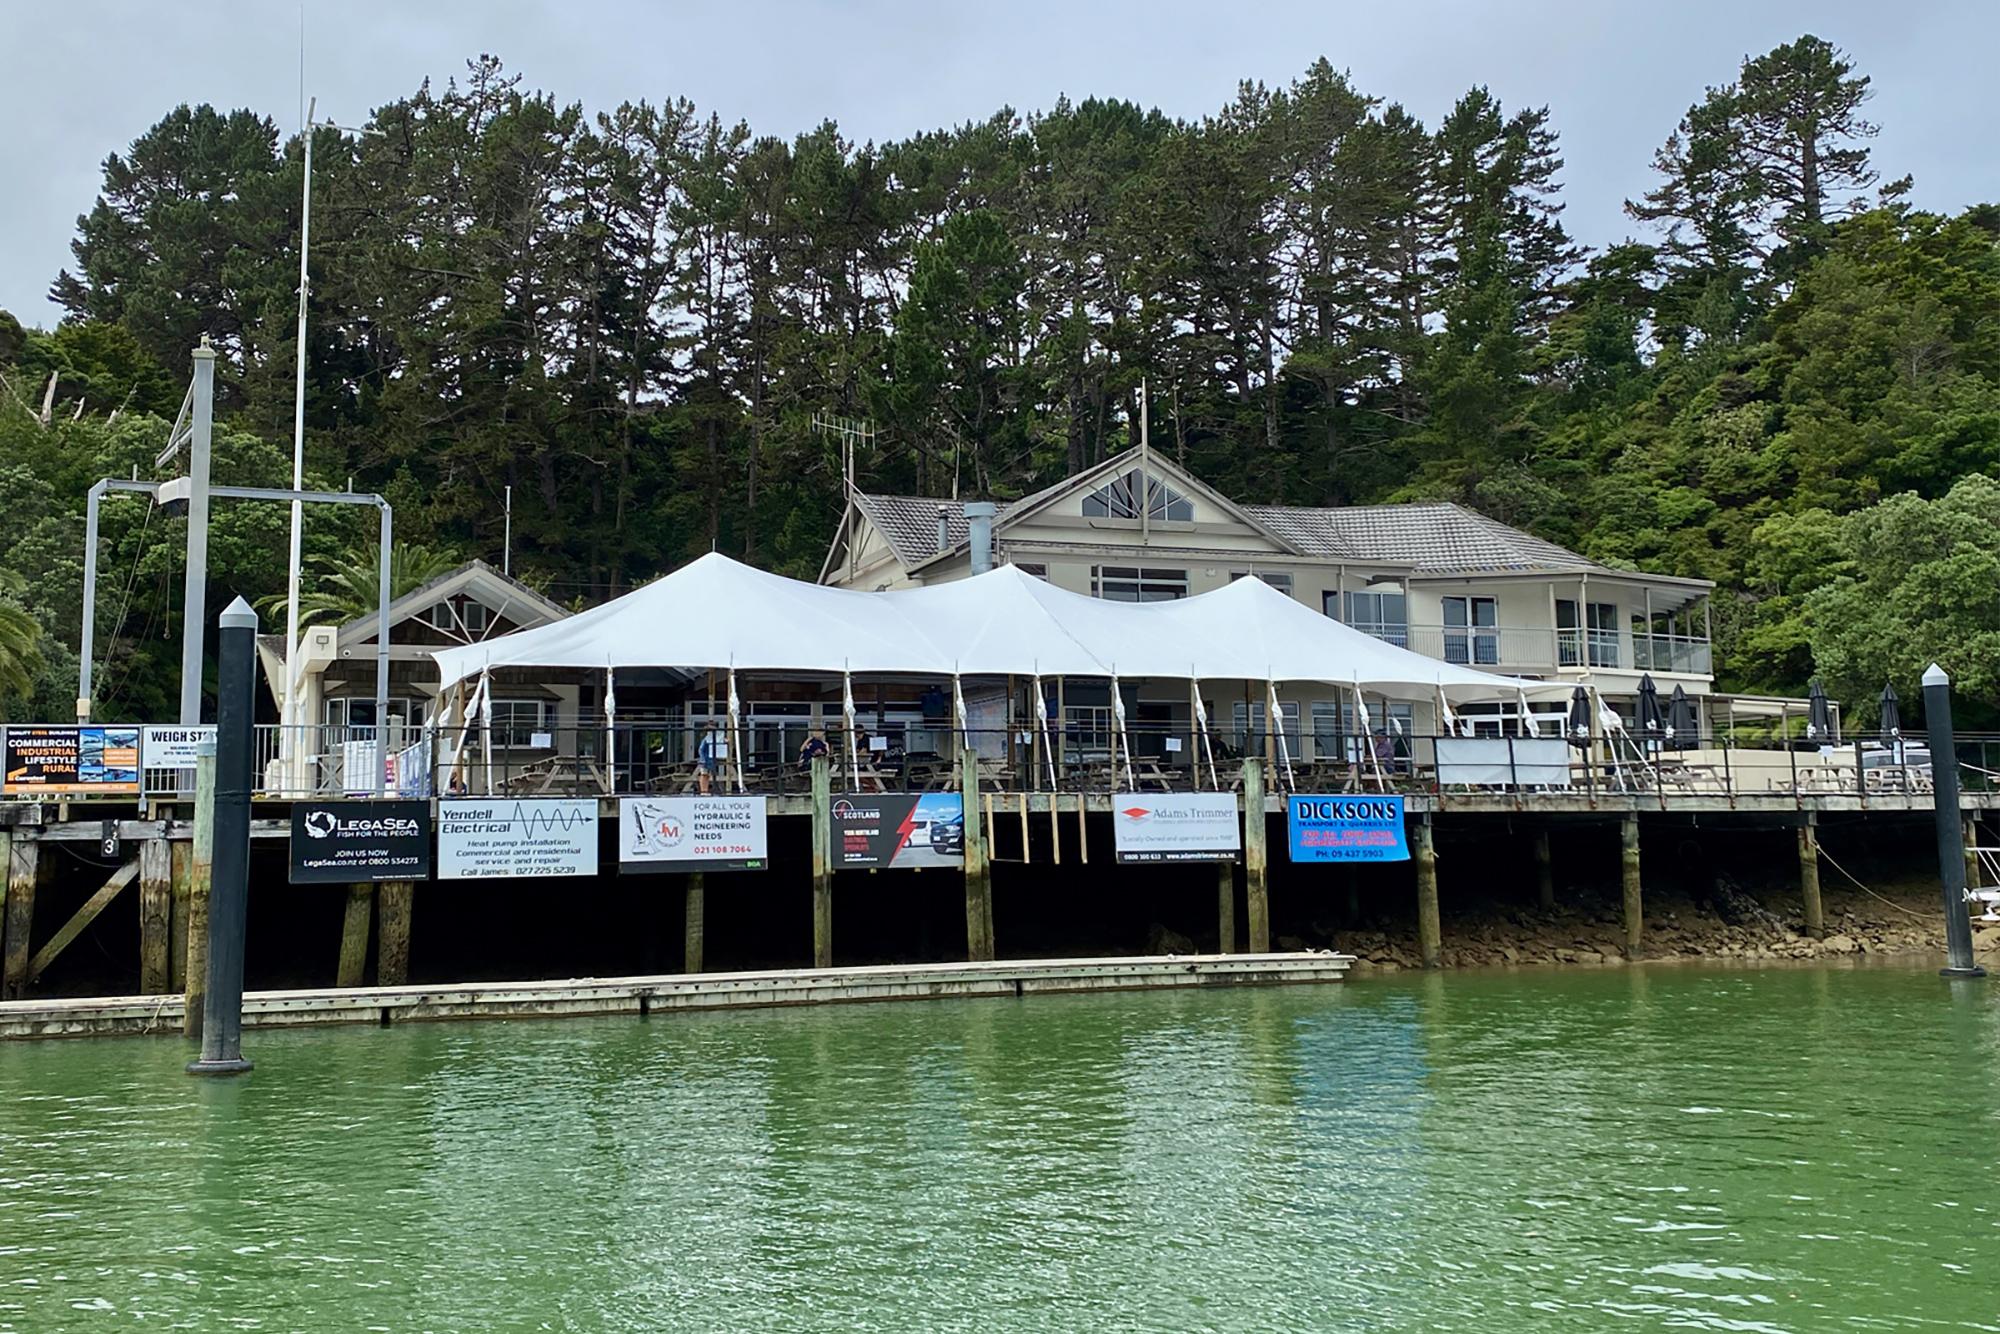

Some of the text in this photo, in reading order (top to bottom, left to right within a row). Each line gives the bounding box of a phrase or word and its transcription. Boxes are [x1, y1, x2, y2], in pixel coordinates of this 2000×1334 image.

[151, 731, 187, 742] WEIGH
[8, 739, 77, 748] COMMERCIAL
[16, 748, 77, 756] INDUSTRIAL
[24, 756, 77, 764] LIFESTYLE
[42, 764, 76, 773] RURAL
[442, 810, 492, 820] Yendell
[1154, 808, 1234, 818] Adams Trimmer
[1297, 801, 1396, 820] DICKSON'S
[694, 812, 744, 820] HYDRAULIC
[843, 812, 880, 820] SCOTLAND
[442, 823, 510, 834] Electrical
[694, 822, 751, 830] ENGINEERING
[104, 838, 114, 854] 3
[335, 850, 354, 858] JOIN
[368, 849, 389, 857] NOW
[456, 850, 510, 858] Commercial
[304, 859, 357, 868] LegaSea.co.nz
[391, 857, 418, 865] 534273
[461, 868, 478, 876] Call
[516, 866, 533, 875] 027
[553, 866, 576, 874] 5239
